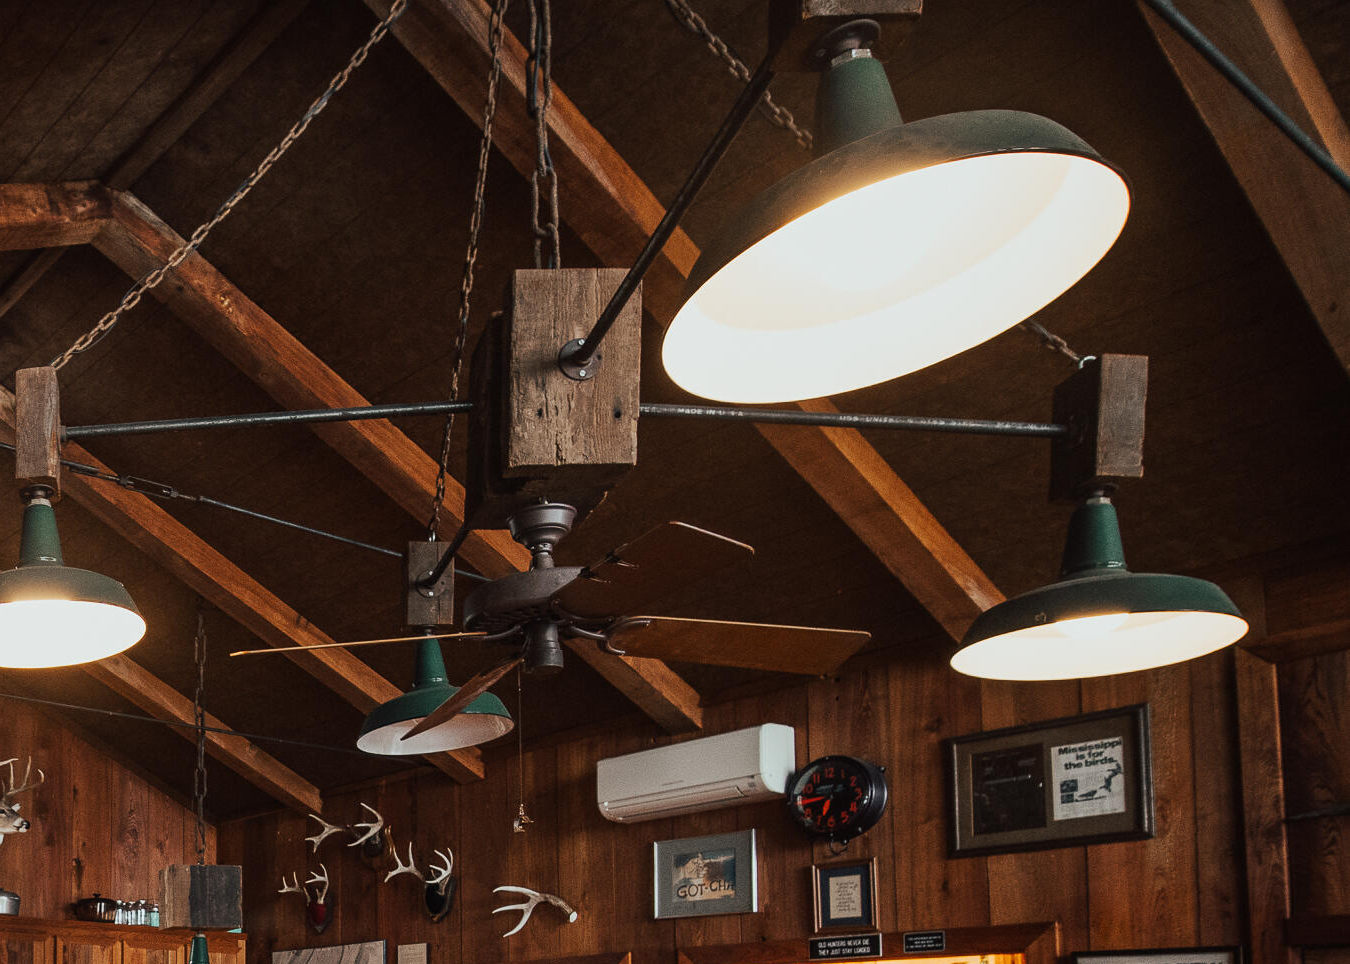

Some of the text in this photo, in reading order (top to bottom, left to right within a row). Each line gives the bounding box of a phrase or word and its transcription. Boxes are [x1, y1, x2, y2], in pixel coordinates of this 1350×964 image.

[1058, 740, 1123, 755] Mississippi
[1076, 750, 1104, 761] is for
[1064, 761, 1083, 770] the
[813, 772, 821, 784] 11
[825, 767, 835, 778] 12
[850, 776, 857, 787] 2
[850, 801, 858, 812] 4
[827, 815, 835, 828] 6
[818, 941, 826, 949] OLD
[827, 940, 846, 948] HUNTERS
[862, 938, 870, 946] DIE
[842, 947, 853, 955] STAY
[853, 946, 871, 954] LOADED
